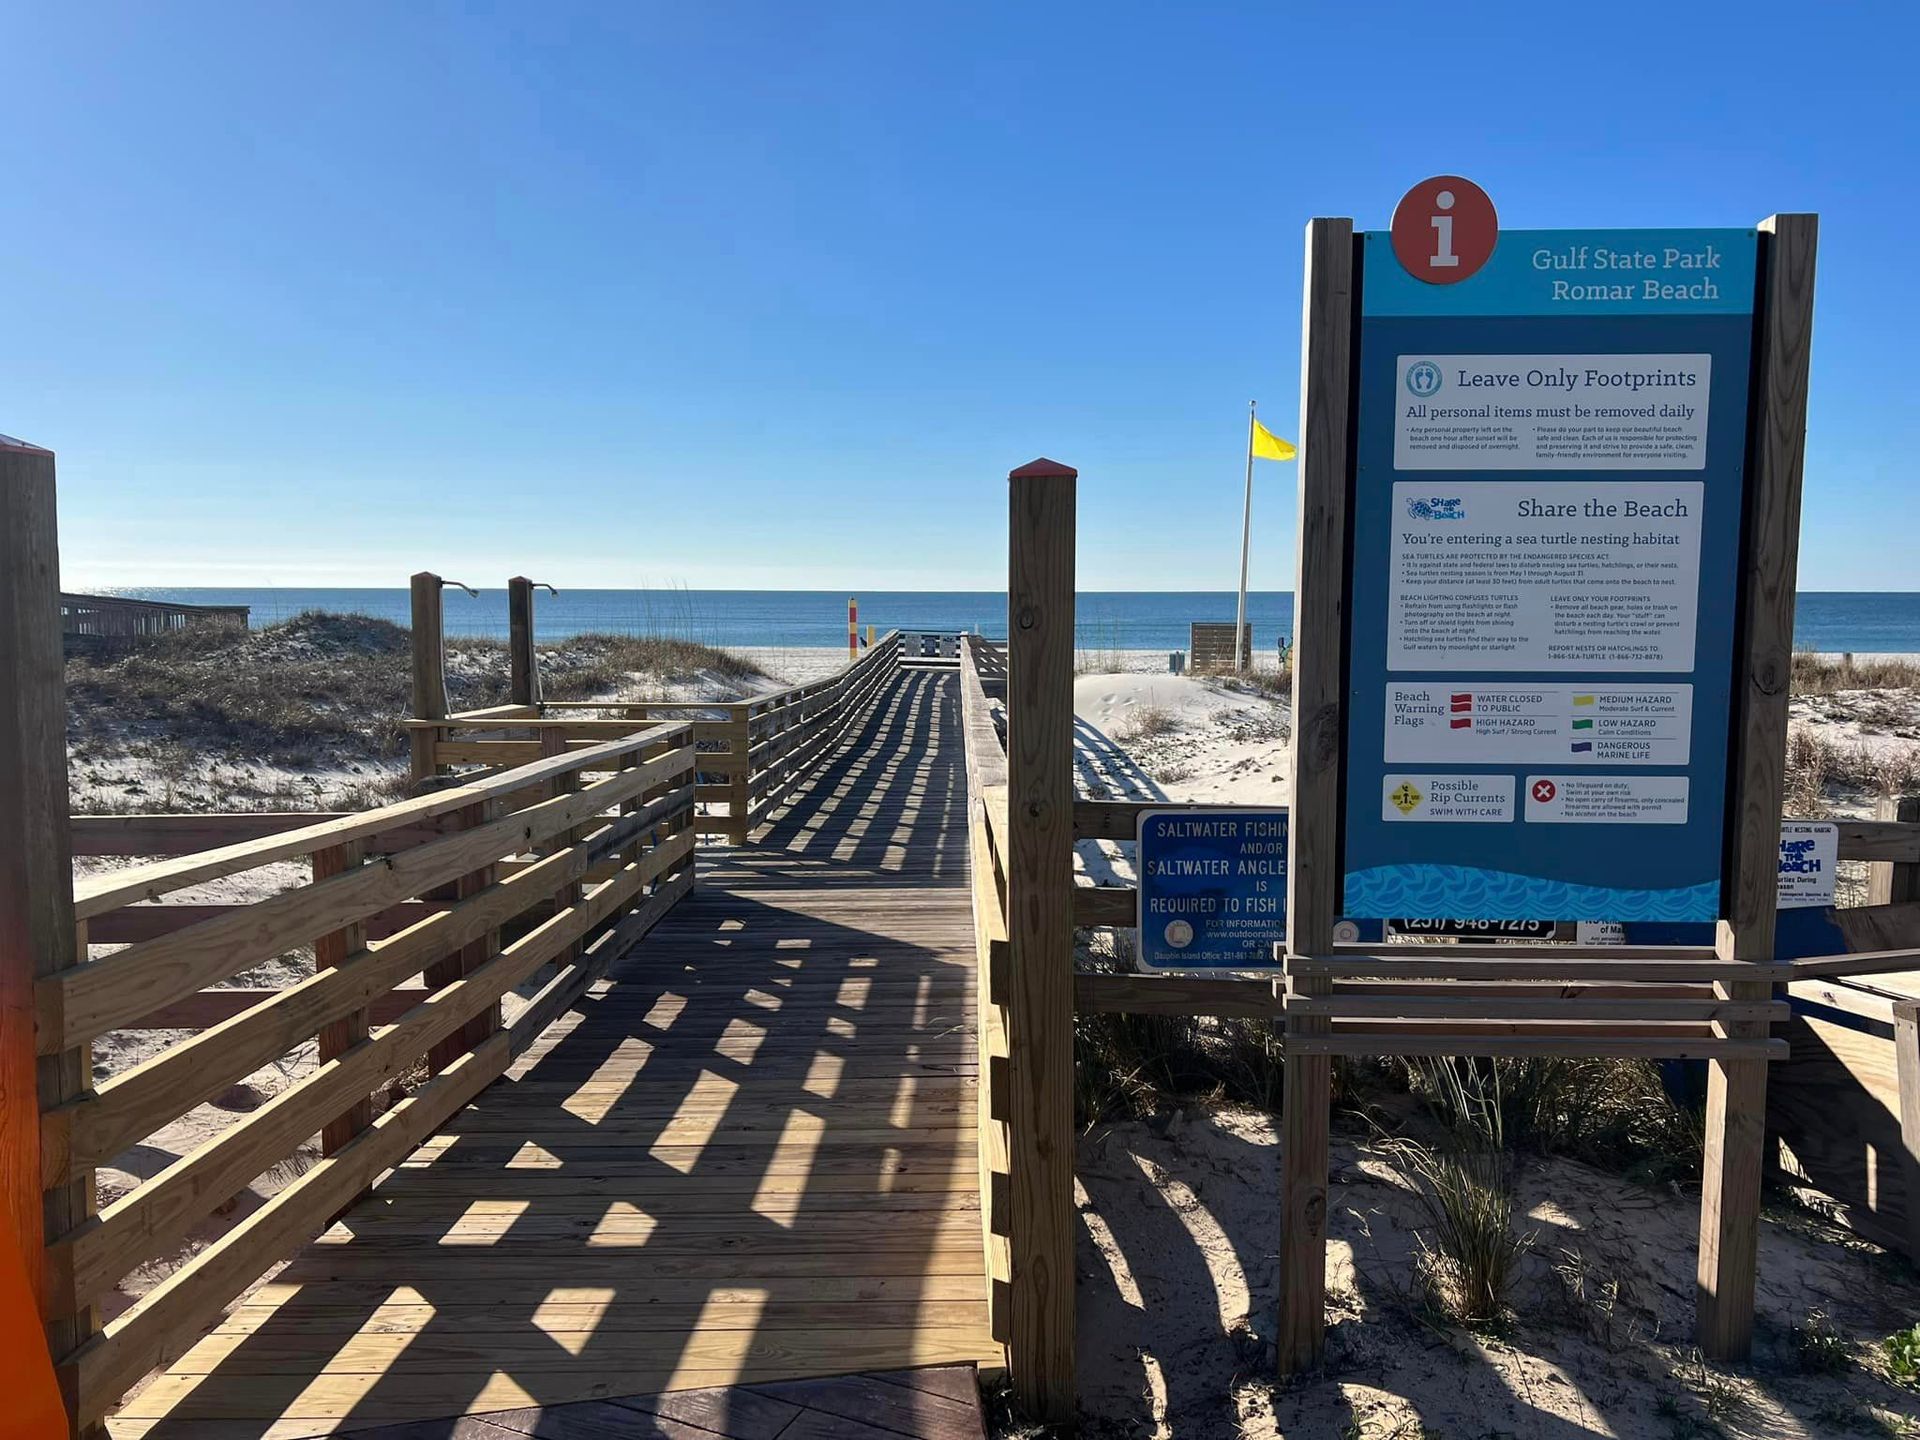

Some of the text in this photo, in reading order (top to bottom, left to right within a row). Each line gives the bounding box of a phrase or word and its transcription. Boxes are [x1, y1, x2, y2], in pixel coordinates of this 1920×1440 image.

[1532, 246, 1721, 270] Gulf State Park
[1552, 276, 1719, 300] Romar Beach
[1458, 370, 1520, 387] Leave
[1526, 368, 1578, 391] Only
[1584, 369, 1696, 391] Footprints
[1406, 404, 1695, 420] All personal items must be removed daily
[1518, 498, 1688, 517] Share the Beach
[1402, 532, 1680, 547] You're entering a sea turtle nesting habitat
[1395, 691, 1430, 701] Beach
[1477, 695, 1542, 703] WATER CLOSED
[1395, 703, 1445, 715] Warning
[1395, 715, 1424, 727] Flags
[1431, 780, 1478, 791] Possible
[1430, 793, 1450, 804] Rip
[1454, 793, 1505, 803] Currents
[1480, 808, 1502, 816] CARE
[1157, 822, 1288, 837] SALTWATER FISHIN
[1240, 843, 1283, 854] AND/OR
[1147, 860, 1286, 875] SALTWATER ANGLE
[1256, 881, 1267, 892] IS
[1150, 898, 1216, 913] REQUIRED
[1224, 898, 1239, 913] TO
[1246, 898, 1276, 912] FISH
[1242, 940, 1255, 948] OR
